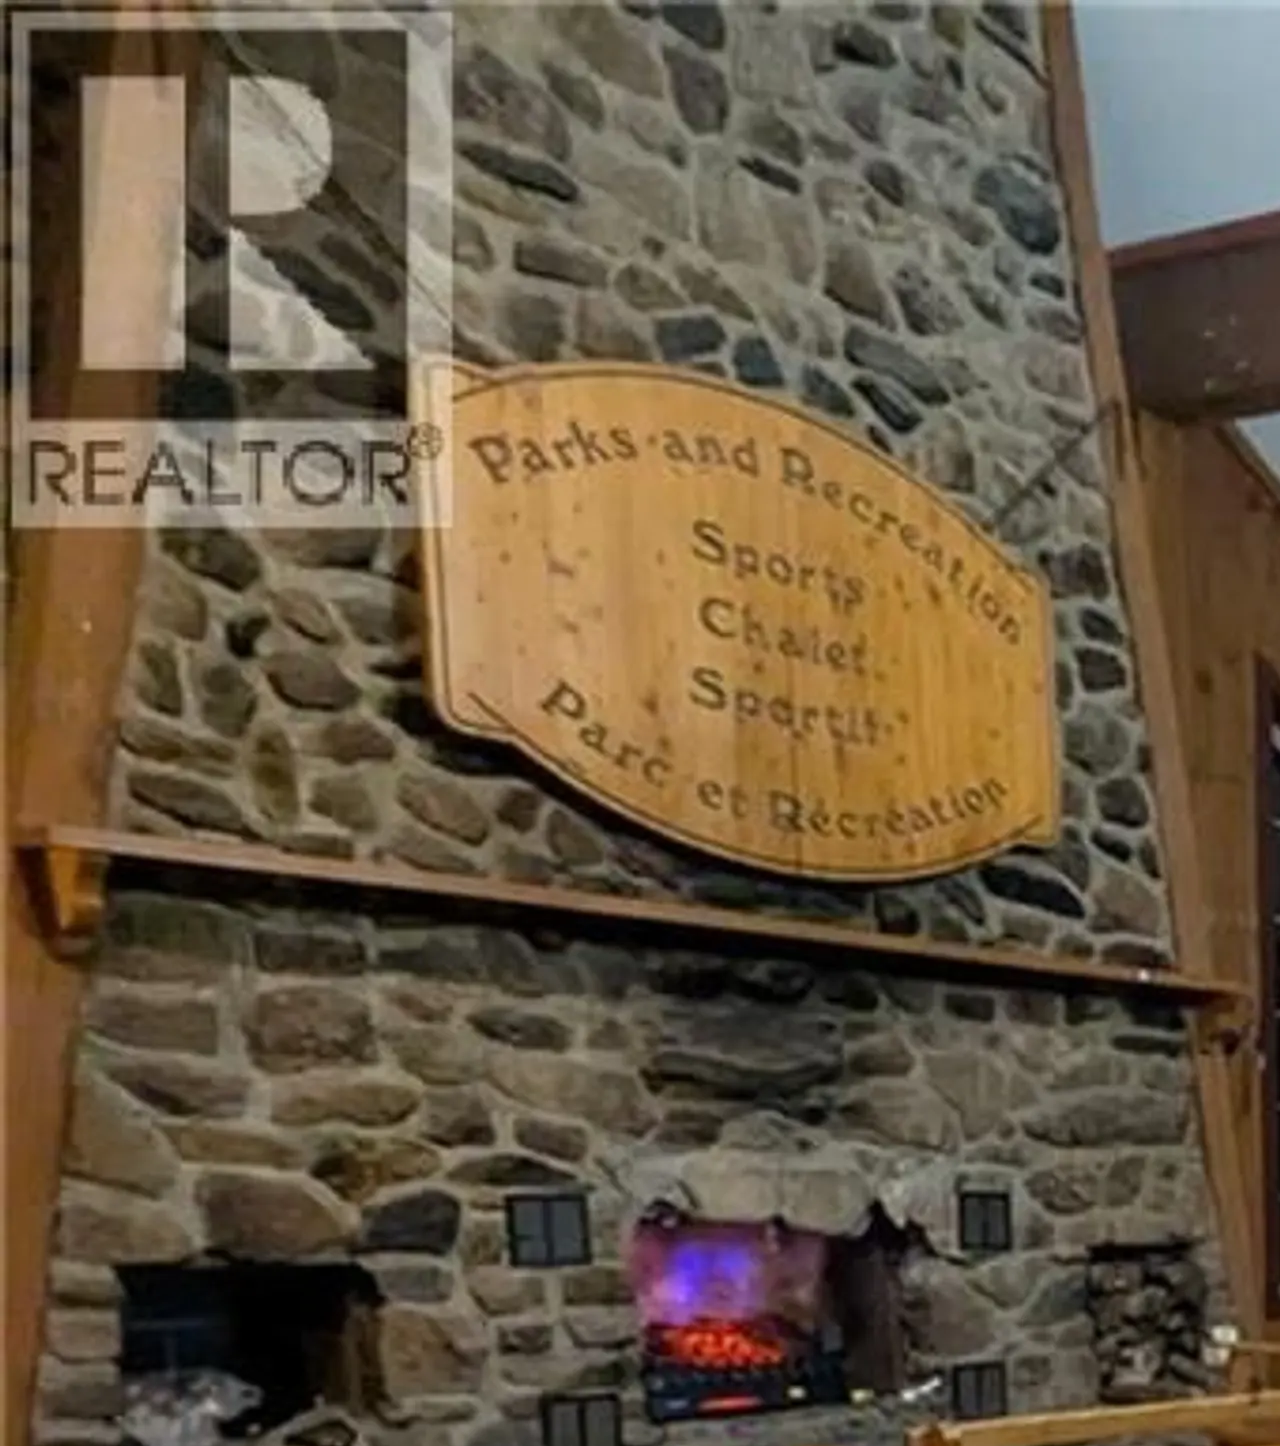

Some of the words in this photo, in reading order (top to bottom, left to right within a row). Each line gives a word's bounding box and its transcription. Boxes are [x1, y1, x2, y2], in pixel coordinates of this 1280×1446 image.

[467, 420, 638, 484] Parks
[662, 428, 760, 478] and
[779, 446, 1021, 646] Recreation
[692, 519, 866, 616] Sports
[699, 597, 868, 678] Chalet
[539, 679, 675, 790] Parc
[697, 777, 751, 819] et
